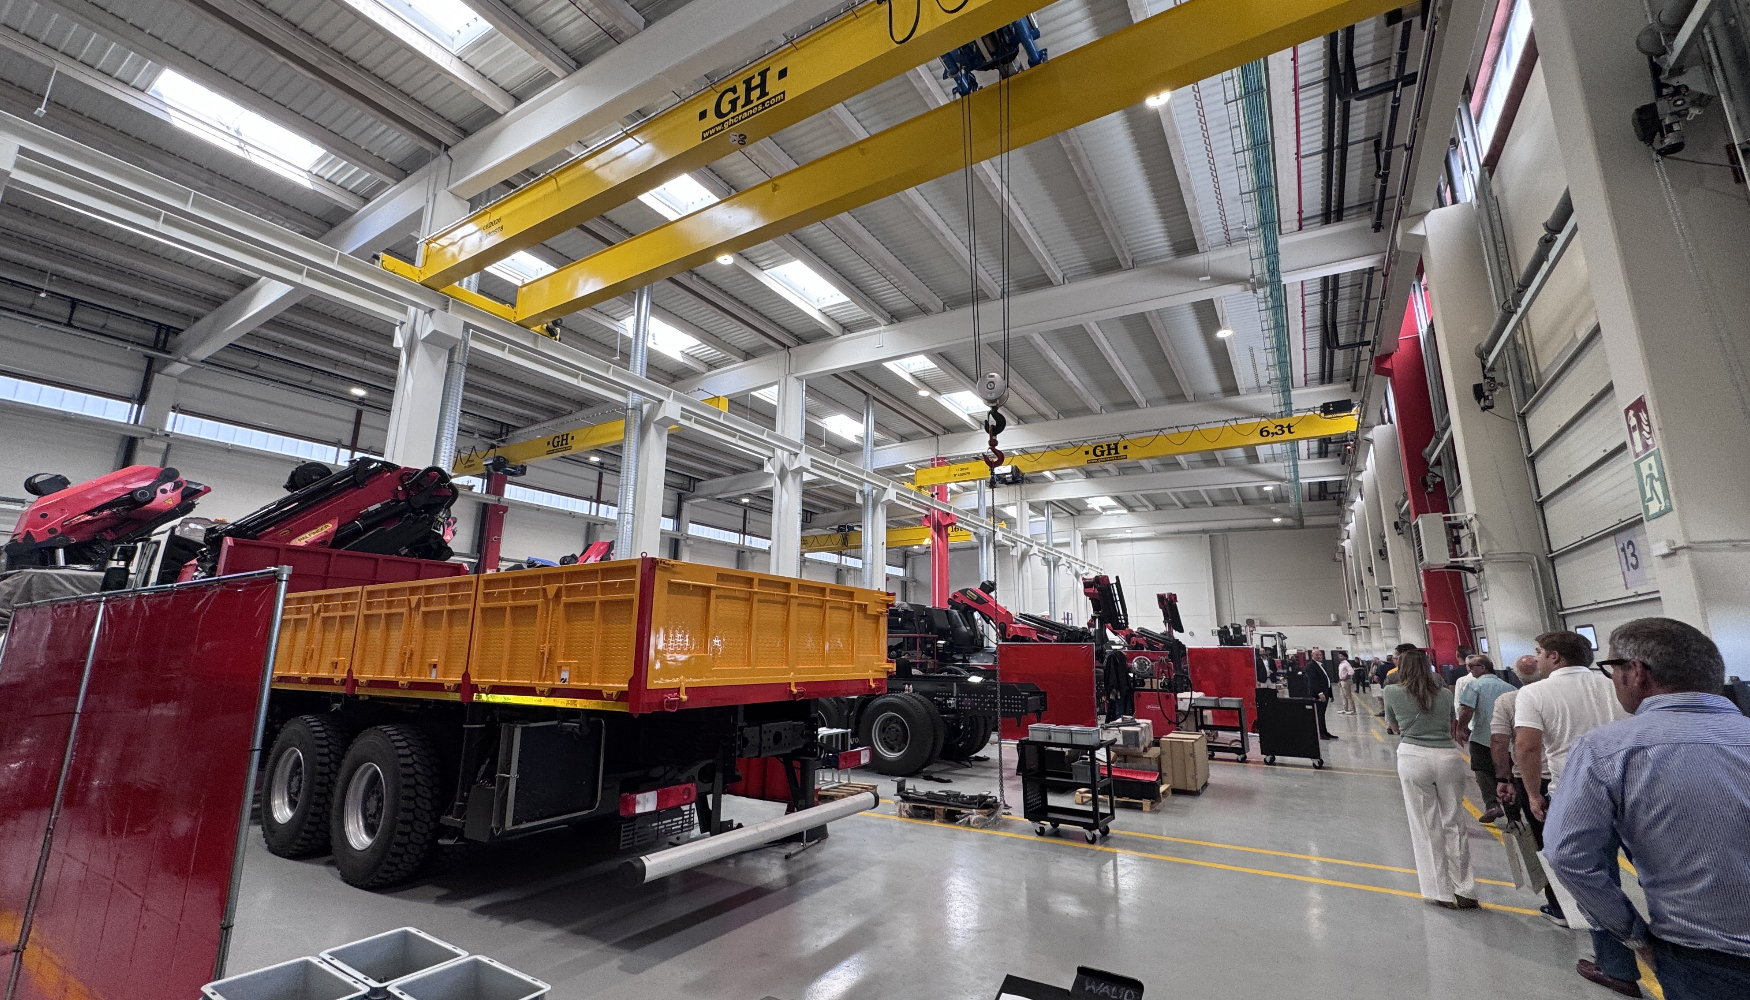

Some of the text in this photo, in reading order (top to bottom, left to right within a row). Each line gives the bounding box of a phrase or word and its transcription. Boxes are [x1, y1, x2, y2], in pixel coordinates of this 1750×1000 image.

[714, 66, 771, 120] GH
[702, 92, 784, 138] www.ghcranes.com
[552, 433, 570, 448] GH
[1092, 442, 1120, 457] GH
[1620, 540, 1640, 572] 13
